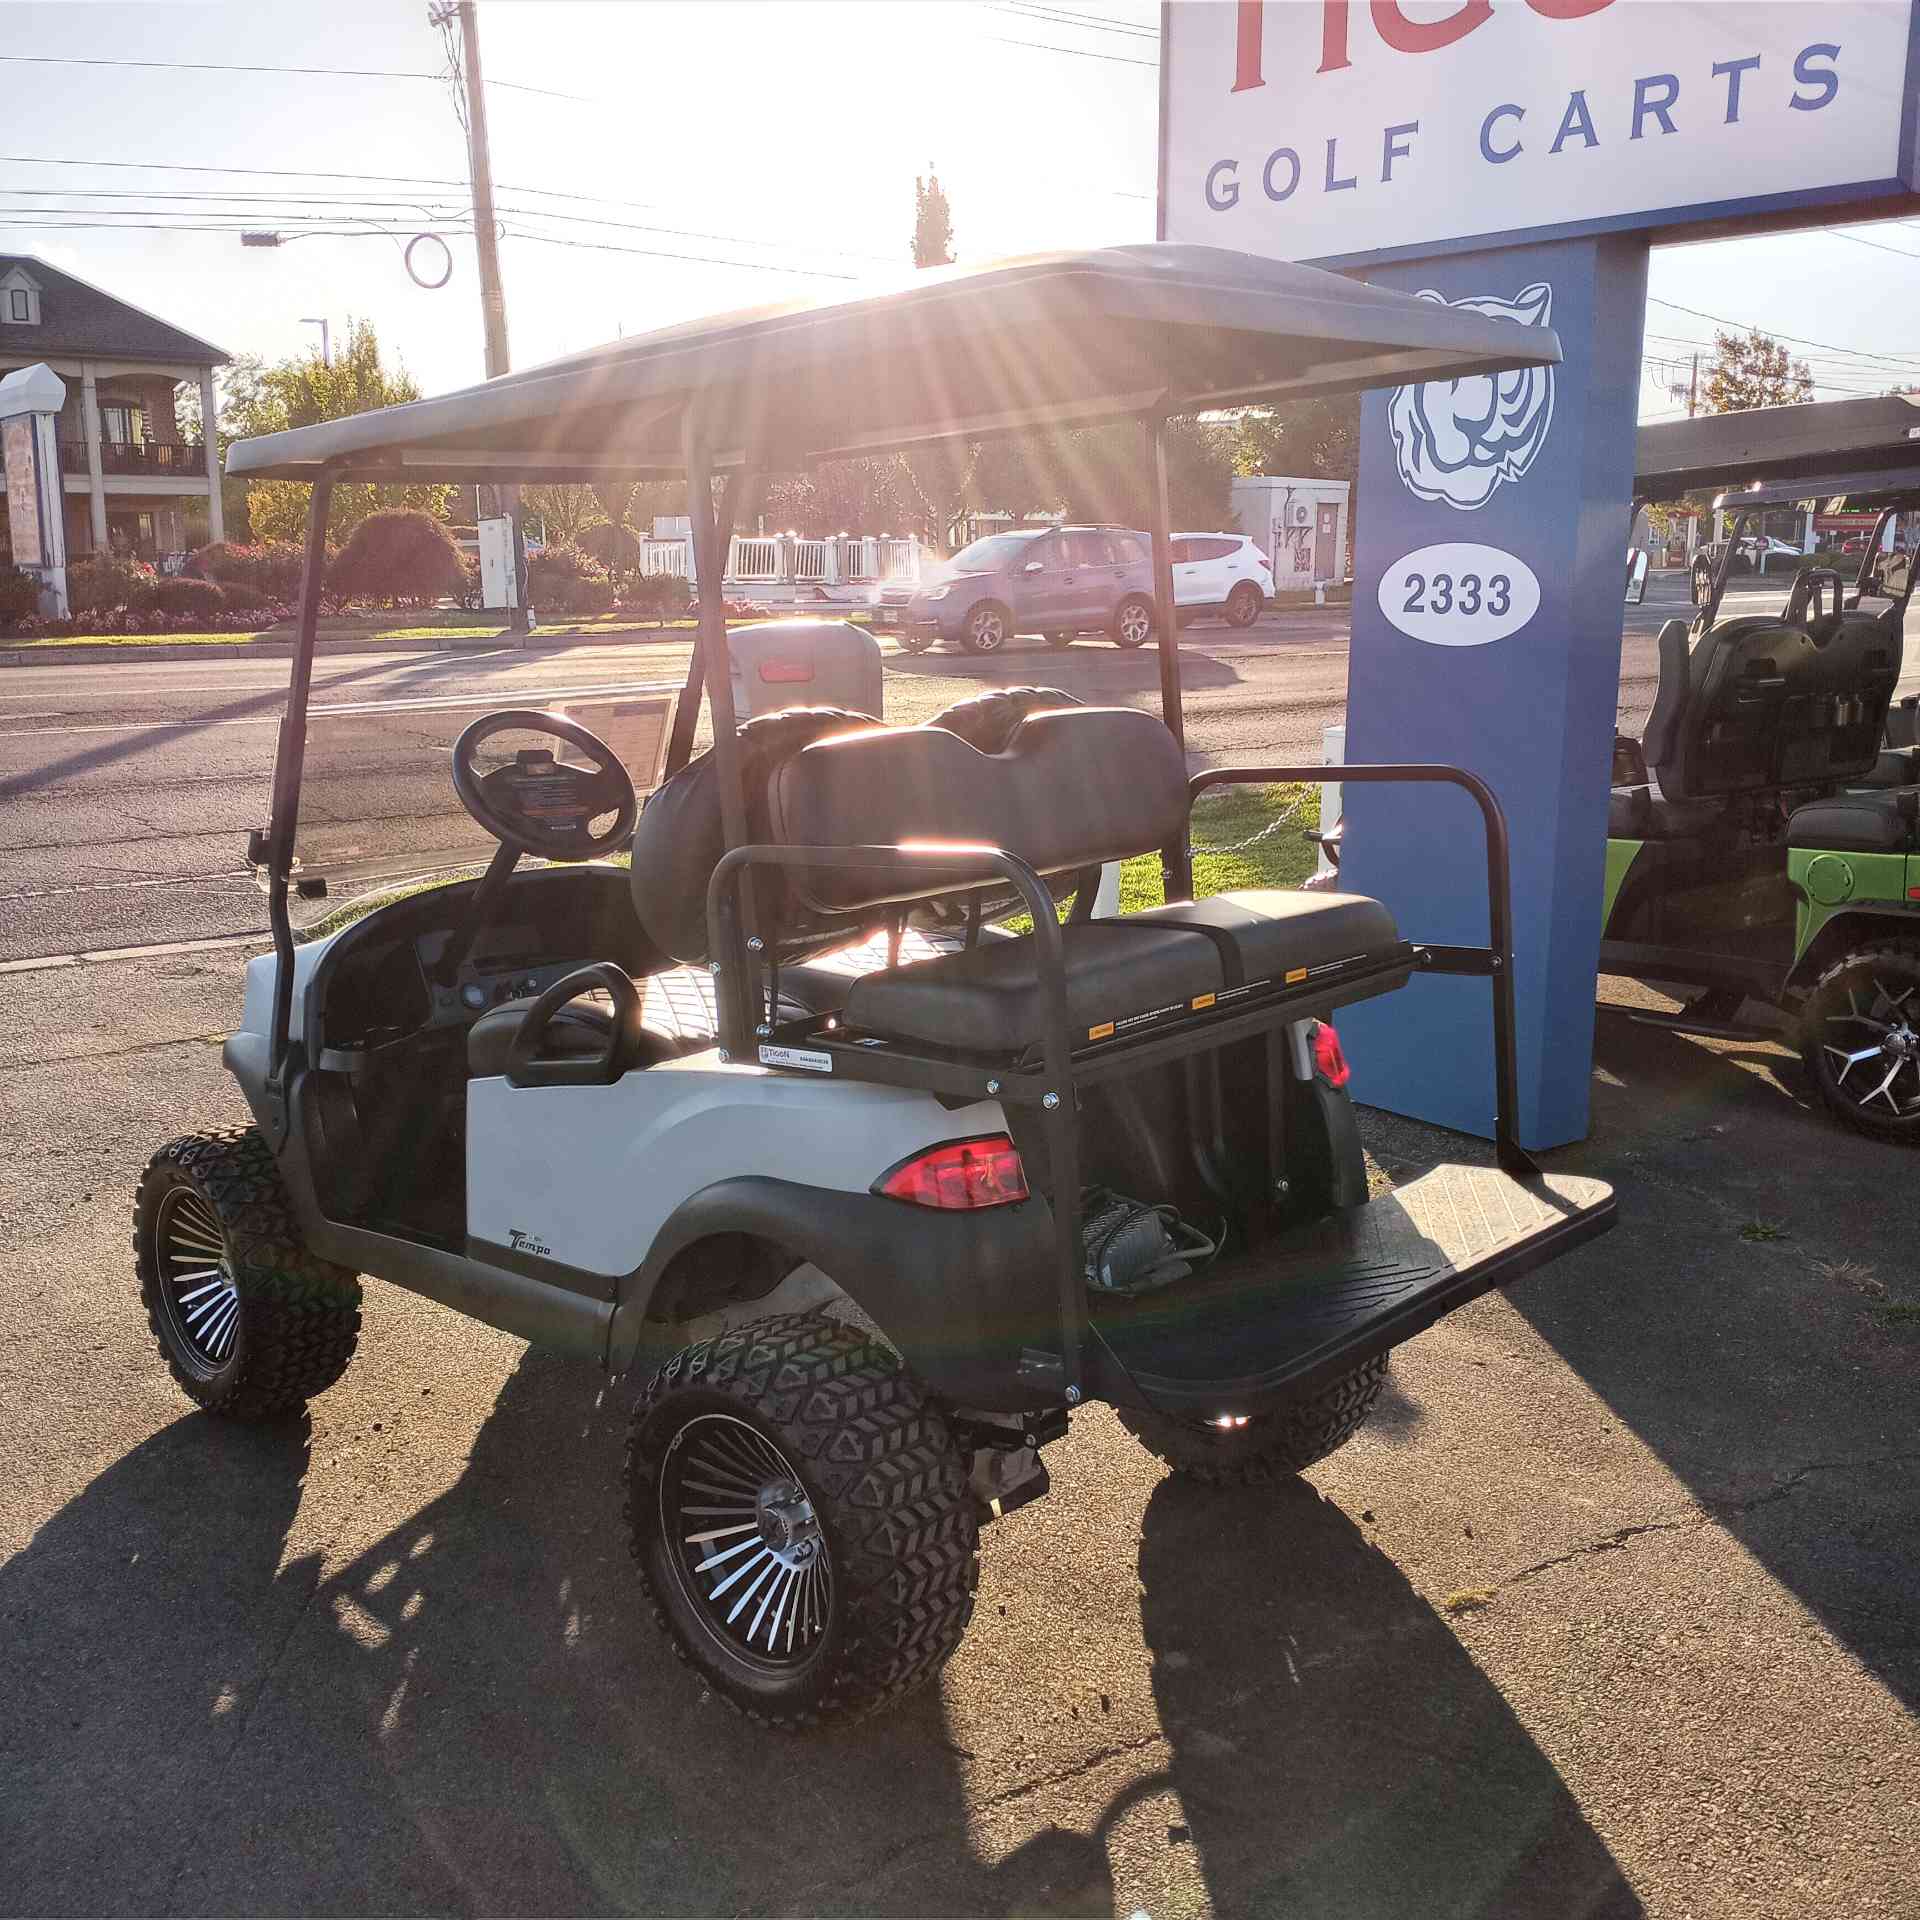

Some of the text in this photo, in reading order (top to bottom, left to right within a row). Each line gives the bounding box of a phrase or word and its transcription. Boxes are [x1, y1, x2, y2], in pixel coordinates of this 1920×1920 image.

[1205, 120, 1419, 211] GOLF
[1480, 43, 1842, 163] CARTS
[1403, 573, 1511, 616] 2333
[509, 1229, 551, 1255] Tempo
